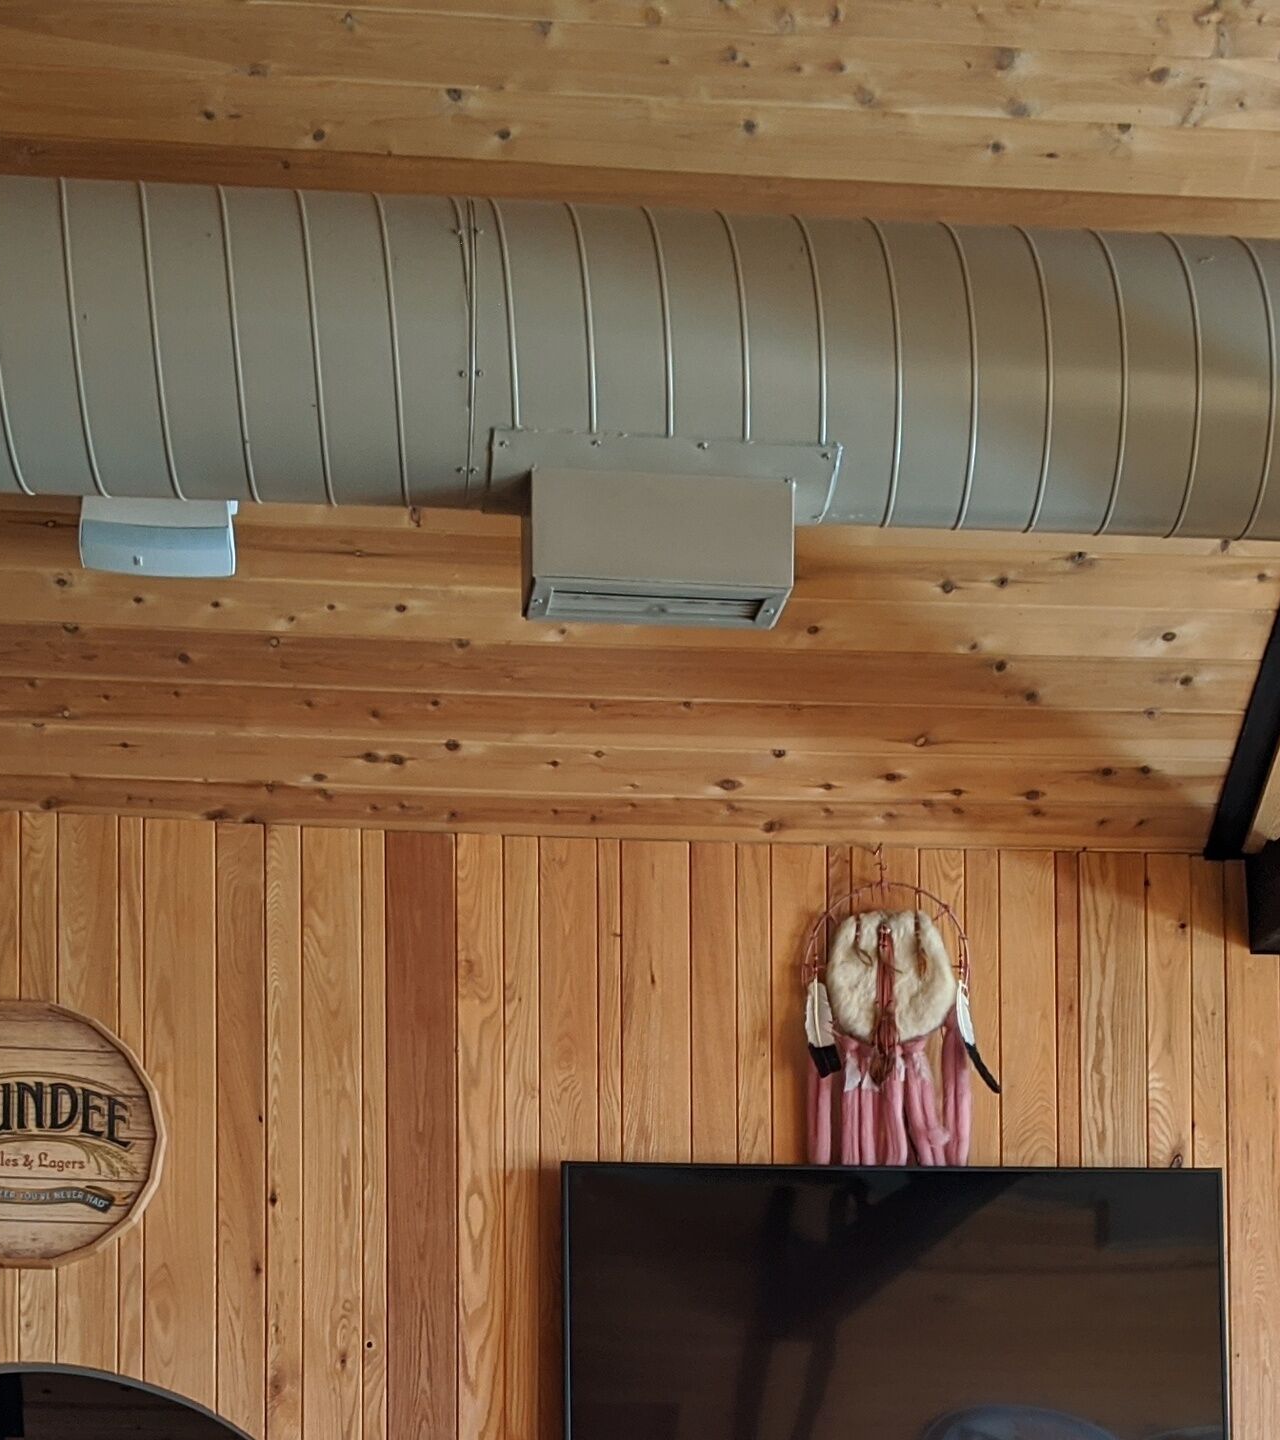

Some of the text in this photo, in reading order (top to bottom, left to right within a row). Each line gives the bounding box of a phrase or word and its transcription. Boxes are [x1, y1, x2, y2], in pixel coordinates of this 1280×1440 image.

[22, 1154, 33, 1170] &
[38, 1152, 85, 1171] Lagers
[53, 1190, 83, 1199] NEVER
